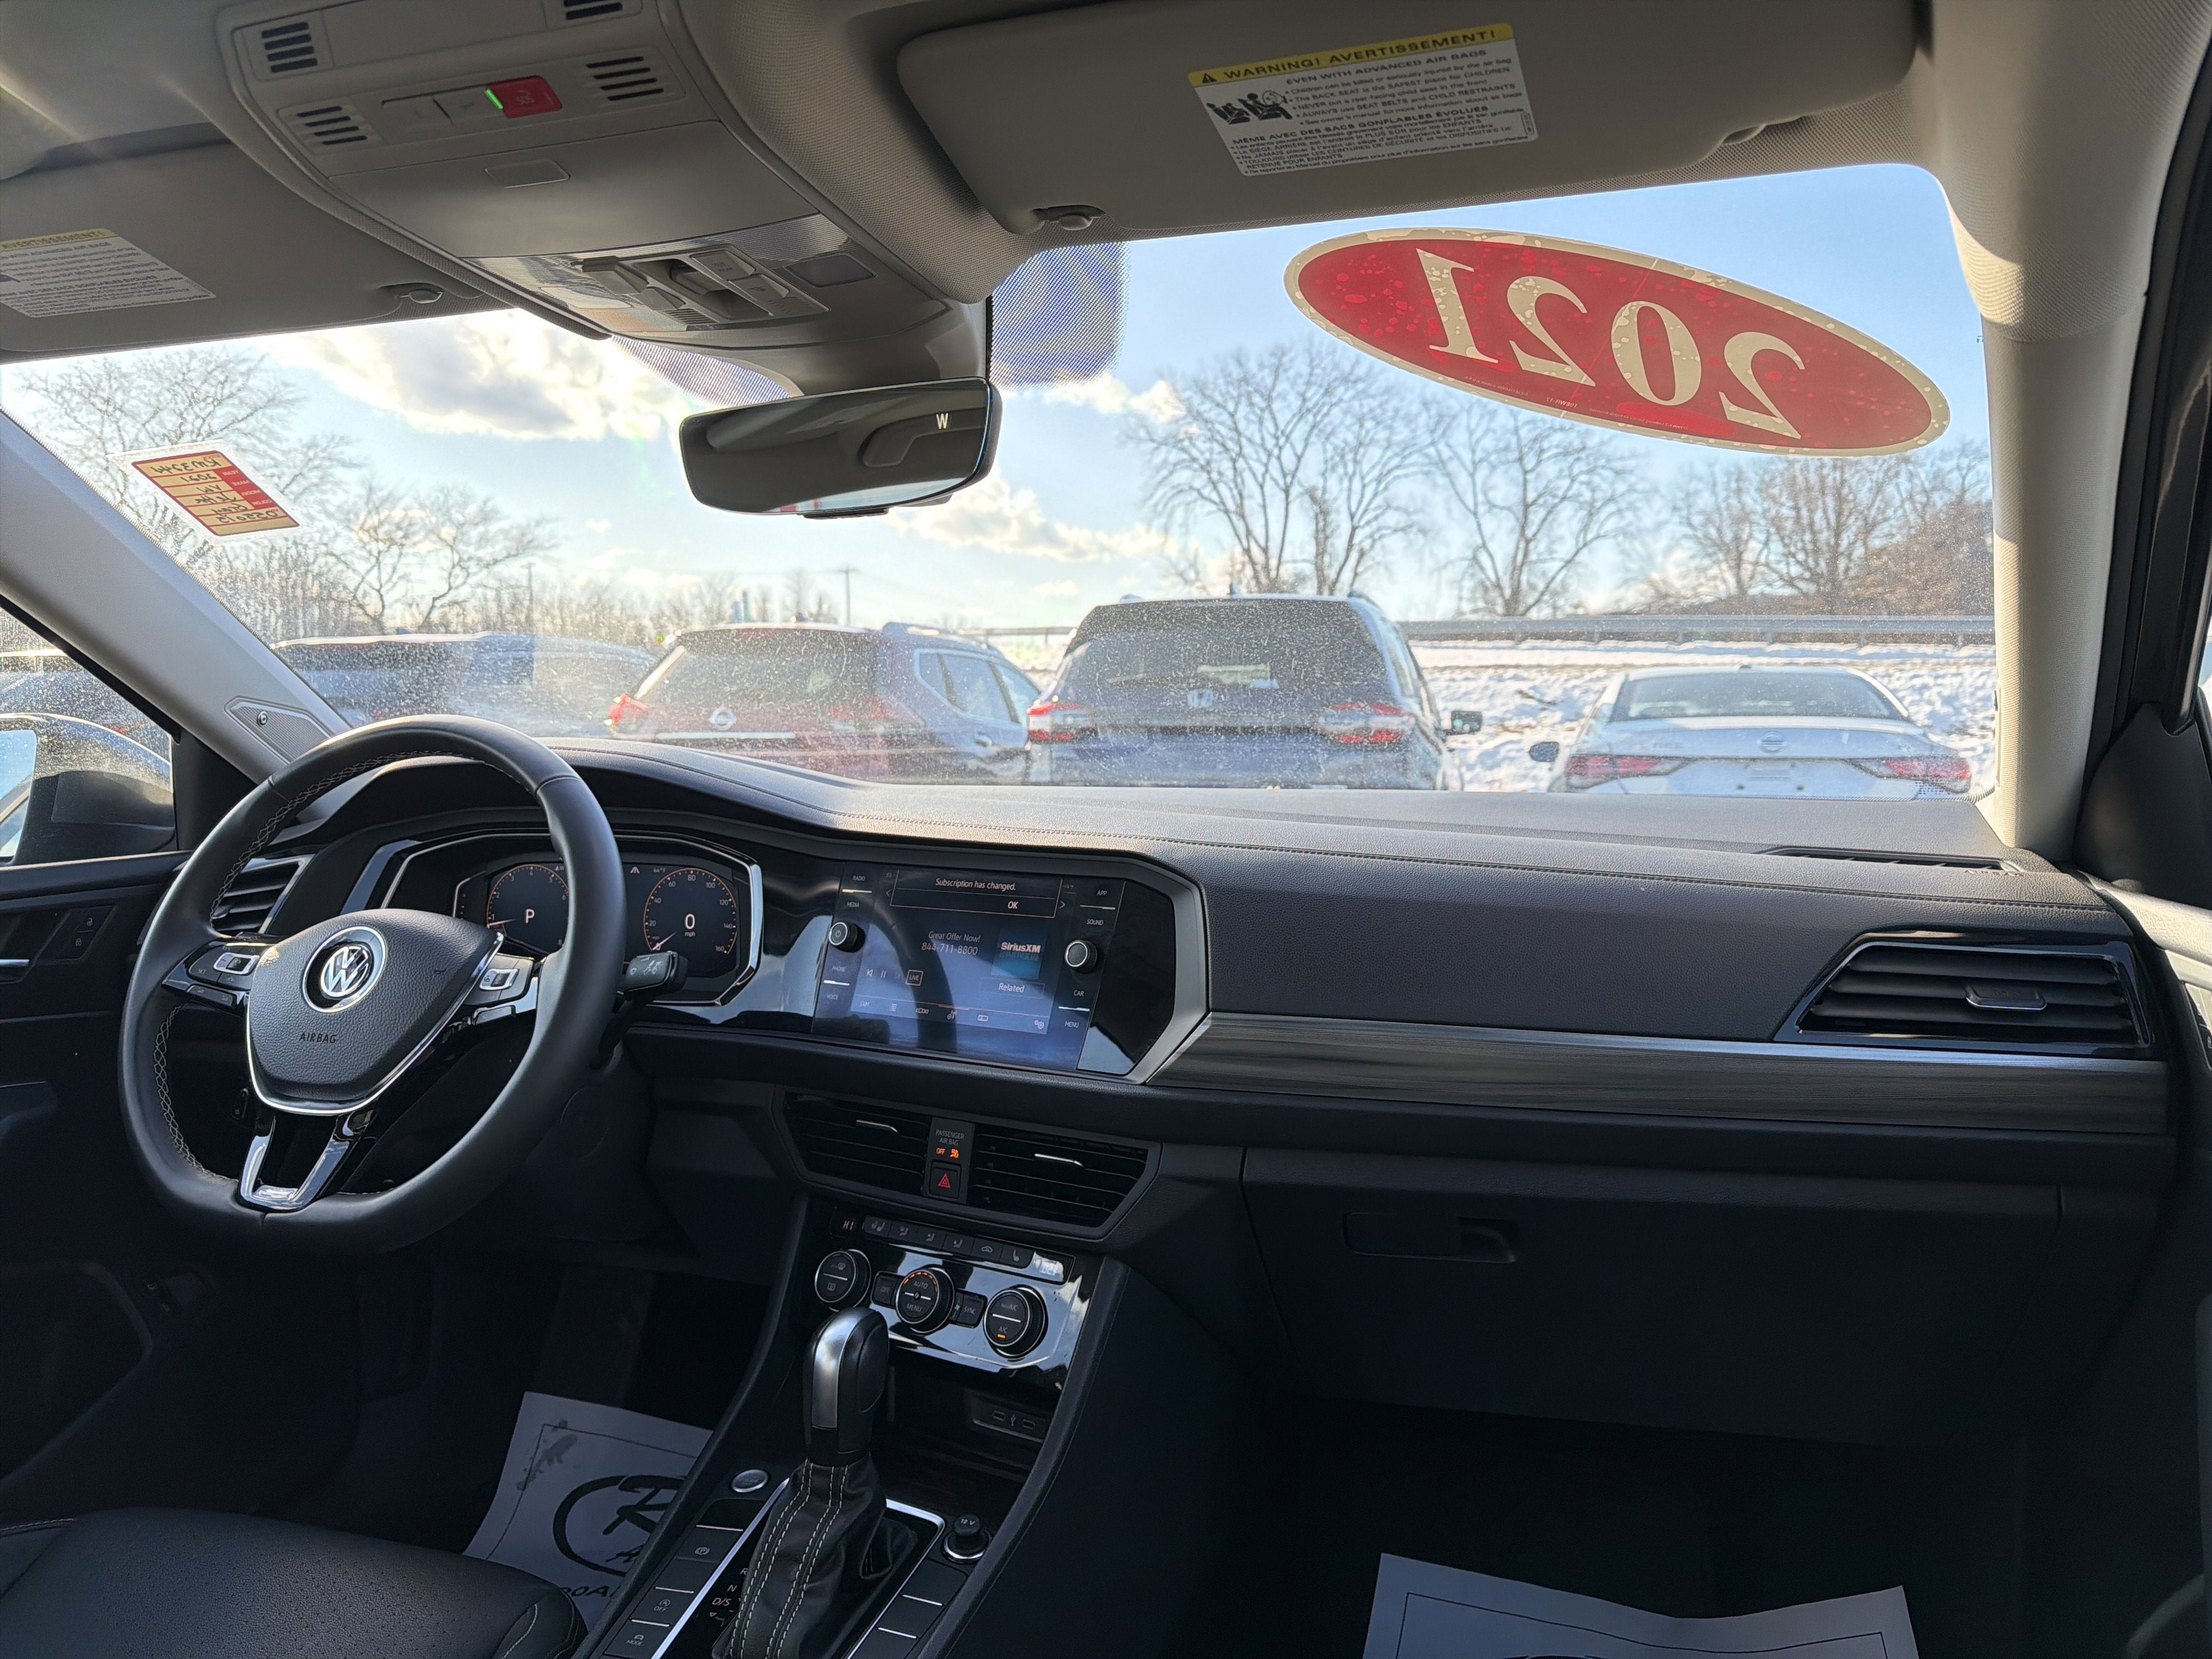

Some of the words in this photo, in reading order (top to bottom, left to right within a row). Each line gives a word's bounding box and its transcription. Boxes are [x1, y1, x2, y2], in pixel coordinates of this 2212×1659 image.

[1223, 57, 1320, 79] WARNING!
[1330, 30, 1494, 64] AVERTISSEMENT!
[1286, 76, 1317, 85] EVEN
[1319, 70, 1351, 79] WITH
[1356, 60, 1421, 74] ADVANCED
[1426, 55, 1447, 64] AIR
[1451, 50, 1486, 60] BAGS
[1291, 84, 1322, 94] Children
[1386, 72, 1421, 80] seriously
[1424, 66, 1451, 75] injured
[1387, 80, 1420, 88] SAFEST
[1464, 66, 1510, 77] CHILDREN
[1298, 101, 1326, 110] NEVER
[1302, 108, 1338, 117] ALWAYS
[1381, 98, 1408, 106] BELTS
[1429, 92, 1455, 100] CHILD
[1458, 83, 1515, 95] RESTRAINTS
[1418, 100, 1463, 109] information
[1269, 131, 1297, 139] AVEC
[1324, 123, 1355, 132] SACS
[1358, 113, 1432, 127] GONFLABLES
[936, 413, 950, 430] W
[935, 878, 973, 889] Subscription
[974, 881, 985, 889] has
[987, 881, 1017, 892] changed.
[1007, 901, 1019, 910] OK
[525, 909, 535, 924] P
[684, 913, 696, 929] 0
[928, 930, 945, 940] Great
[946, 932, 962, 941] Offer
[963, 934, 981, 943] Now!
[922, 942, 978, 955] 844-711-8800
[1001, 941, 1041, 953] SiriusXM
[998, 982, 1025, 993] Related
[1064, 1020, 1080, 1029] MENU
[299, 1032, 337, 1043] AIRBAG
[935, 1129, 964, 1139] PASSENGER
[940, 1137, 948, 1145] AIR
[913, 1281, 928, 1289] AUTO
[906, 1303, 922, 1312] MENU
[964, 1306, 976, 1315] SYNC
[998, 1325, 1008, 1334] A/C
[727, 1584, 738, 1592] N
[712, 1597, 732, 1606] D/S
